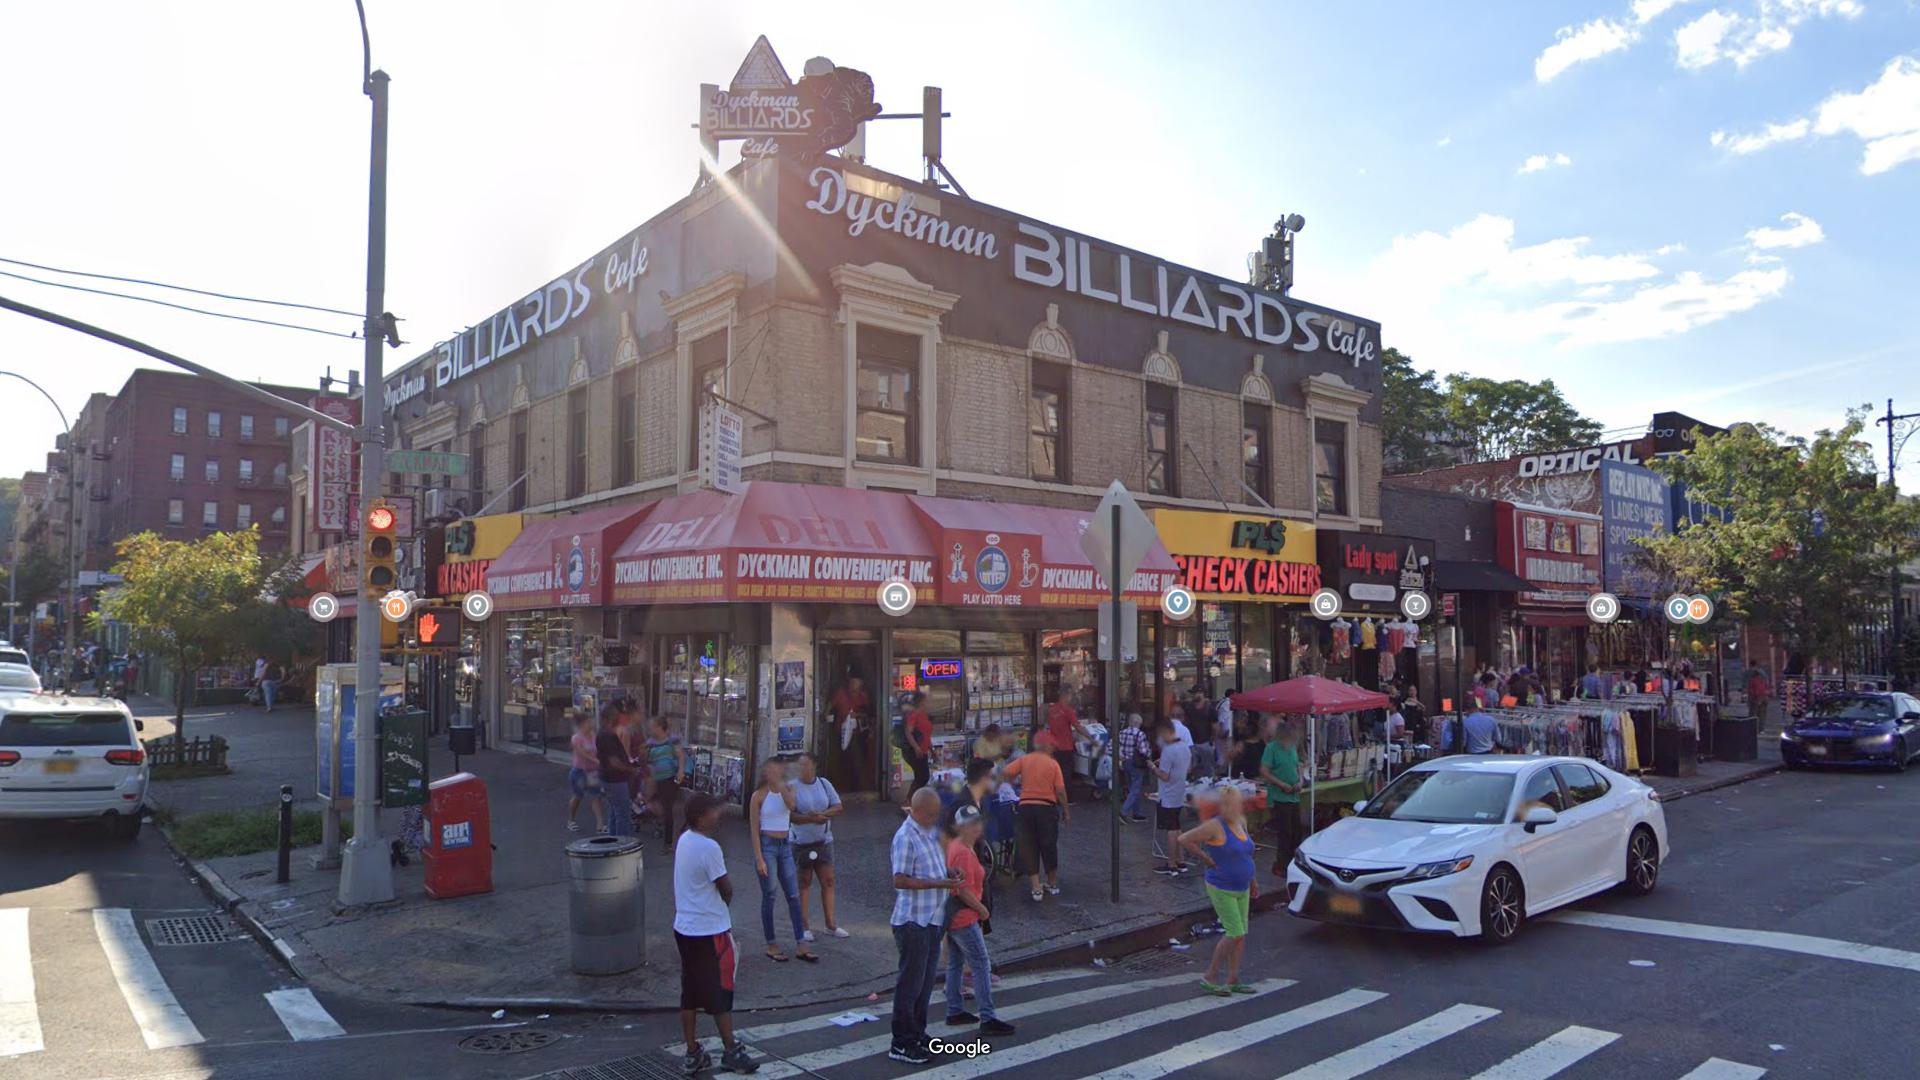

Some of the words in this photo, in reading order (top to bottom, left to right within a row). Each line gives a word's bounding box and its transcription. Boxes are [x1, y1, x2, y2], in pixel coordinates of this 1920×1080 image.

[706, 108, 815, 130] BILLIARDS
[741, 137, 779, 155] Cafe
[806, 166, 998, 259] Dyckman
[1014, 222, 1320, 352] BILLIARDS
[1327, 319, 1374, 367] Cafe
[436, 258, 595, 388] BILLIARDS
[604, 236, 648, 294] Cafe
[1519, 443, 1640, 477] OPTICAL
[1611, 499, 1640, 522] LADIES
[638, 514, 722, 549] DELI
[757, 513, 889, 549] DELI
[615, 559, 649, 584] DYCKMAN
[650, 555, 704, 581] CONVENIENCE
[737, 553, 811, 578] DYCKMAN
[814, 556, 907, 583] CONVENIENCE
[909, 561, 934, 583] INC.
[1345, 543, 1372, 575] Lady
[1374, 549, 1398, 576] spot
[1042, 568, 1093, 589] DYCKMAN
[1253, 559, 1322, 595] CASHERS
[963, 593, 980, 604] PLAY
[981, 594, 1002, 604] LOTTO
[1004, 594, 1022, 605] HERE
[926, 663, 959, 676] OPEN
